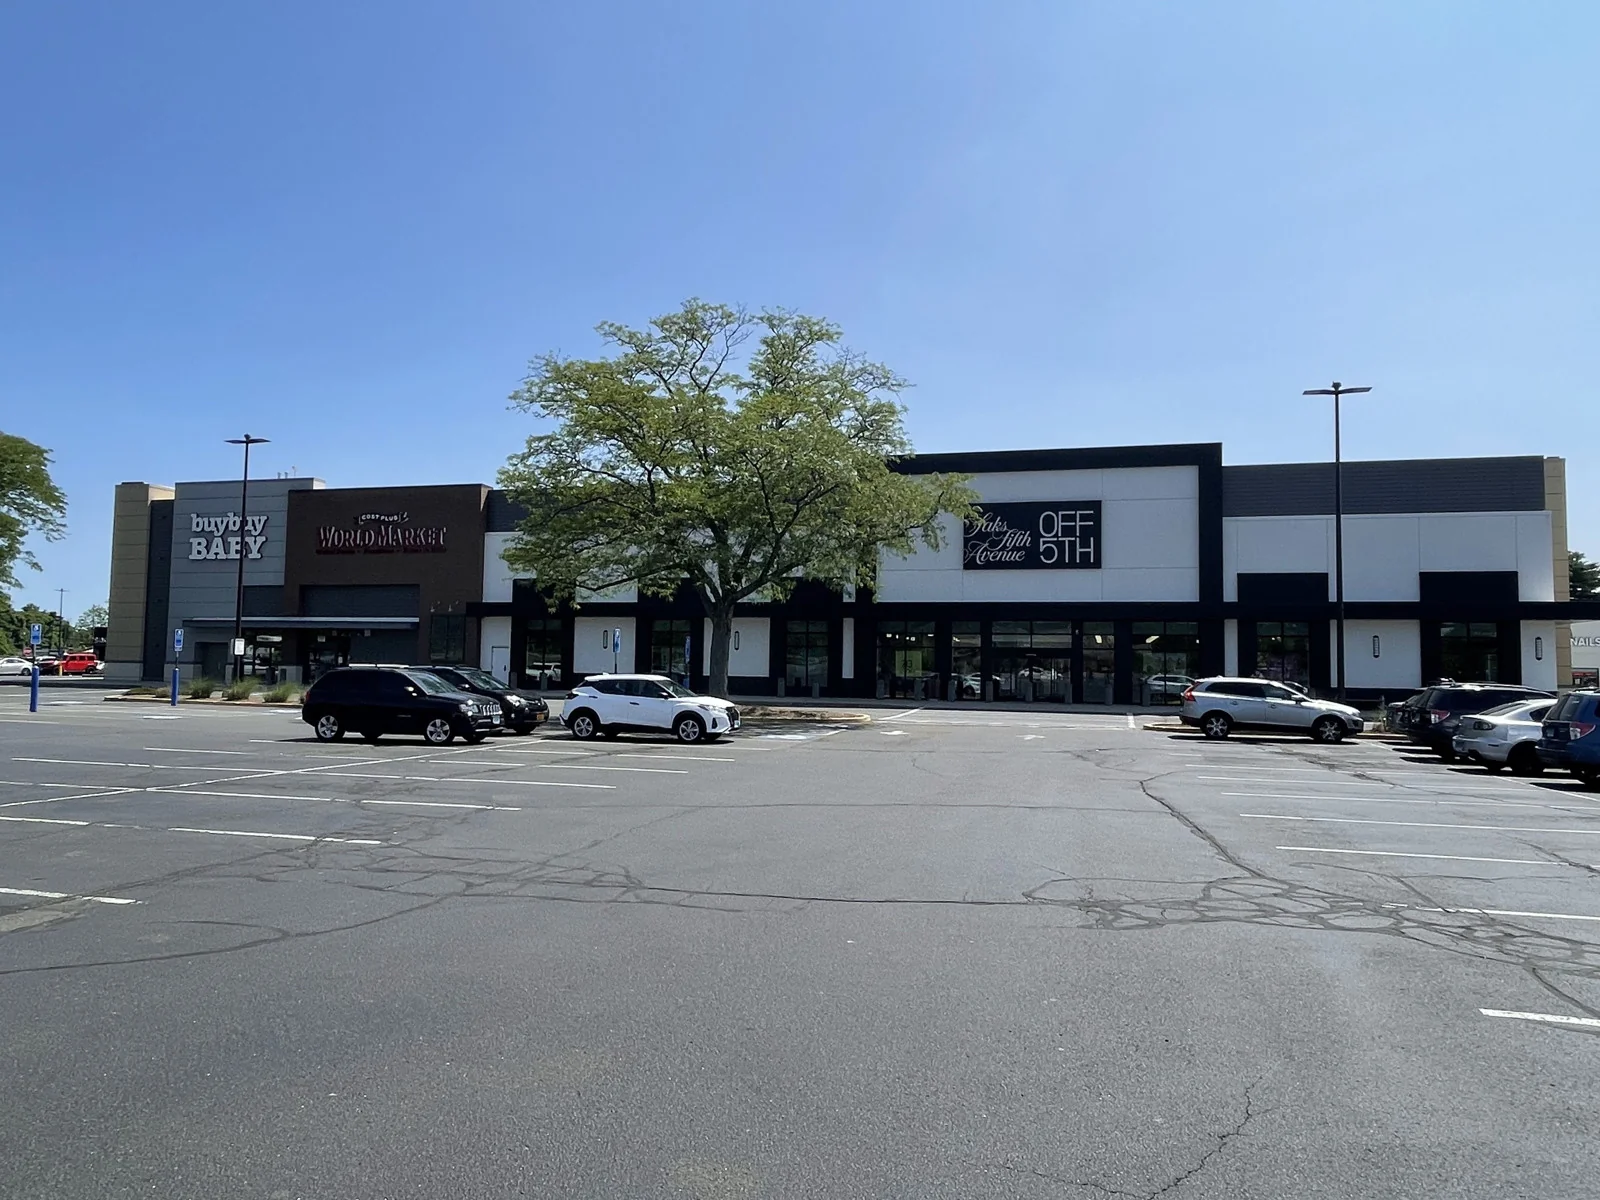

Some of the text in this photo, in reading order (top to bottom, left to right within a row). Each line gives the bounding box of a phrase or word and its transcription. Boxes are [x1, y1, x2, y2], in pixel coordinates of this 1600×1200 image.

[361, 513, 380, 521] COST
[1039, 510, 1094, 538] OFF
[188, 535, 268, 560] BABY
[318, 524, 447, 548] WORLD MARKET
[964, 540, 1026, 565] Avenue
[1039, 537, 1094, 564] 5TH
[1570, 636, 1600, 647] NAILS
